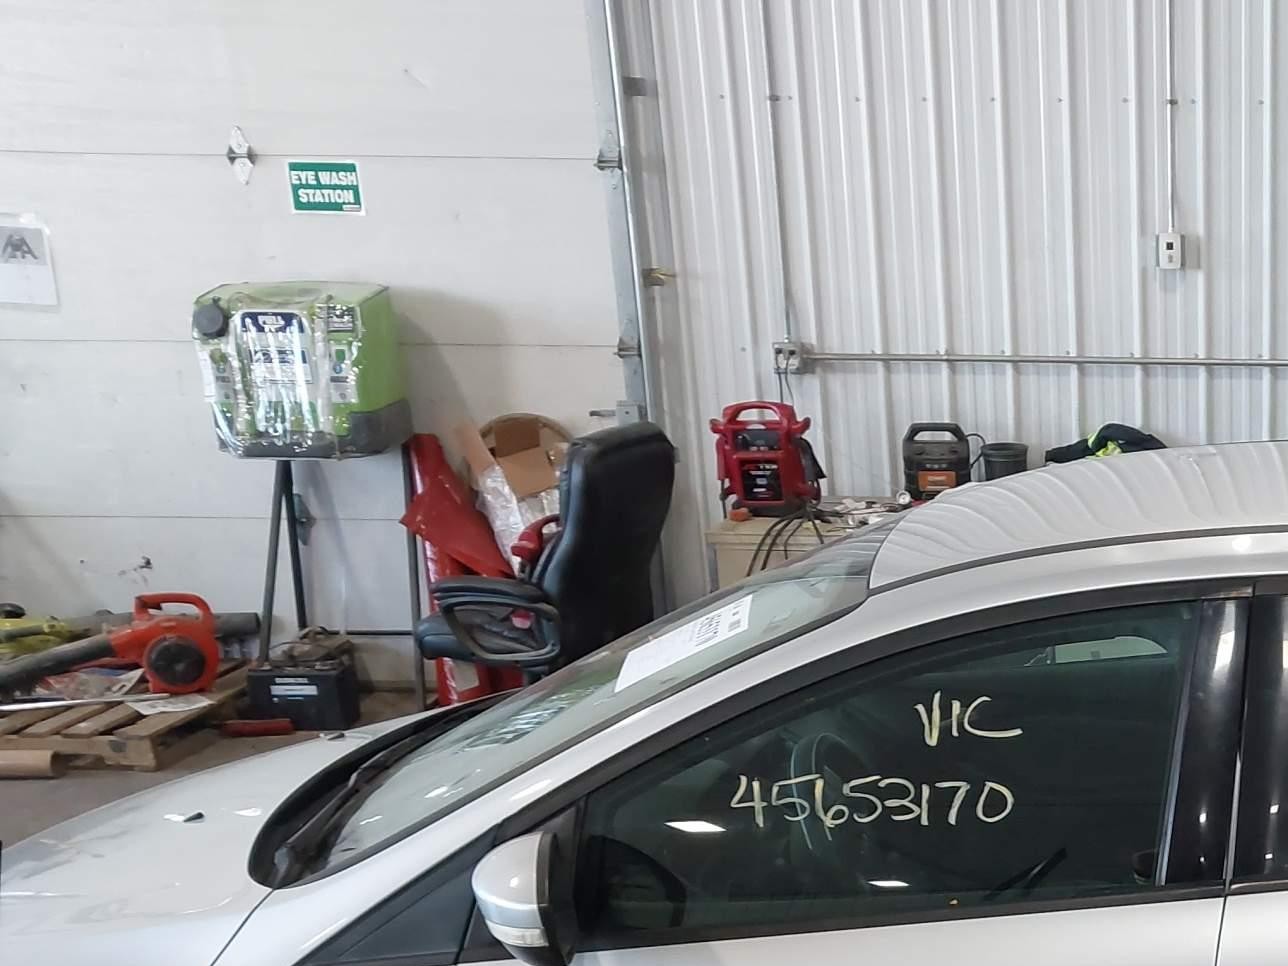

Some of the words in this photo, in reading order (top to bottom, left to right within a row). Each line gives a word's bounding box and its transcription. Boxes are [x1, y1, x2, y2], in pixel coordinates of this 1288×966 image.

[289, 170, 317, 185] EYE
[317, 170, 358, 186] WASH
[297, 188, 356, 203] STATION
[729, 774, 1015, 828] 45653170
